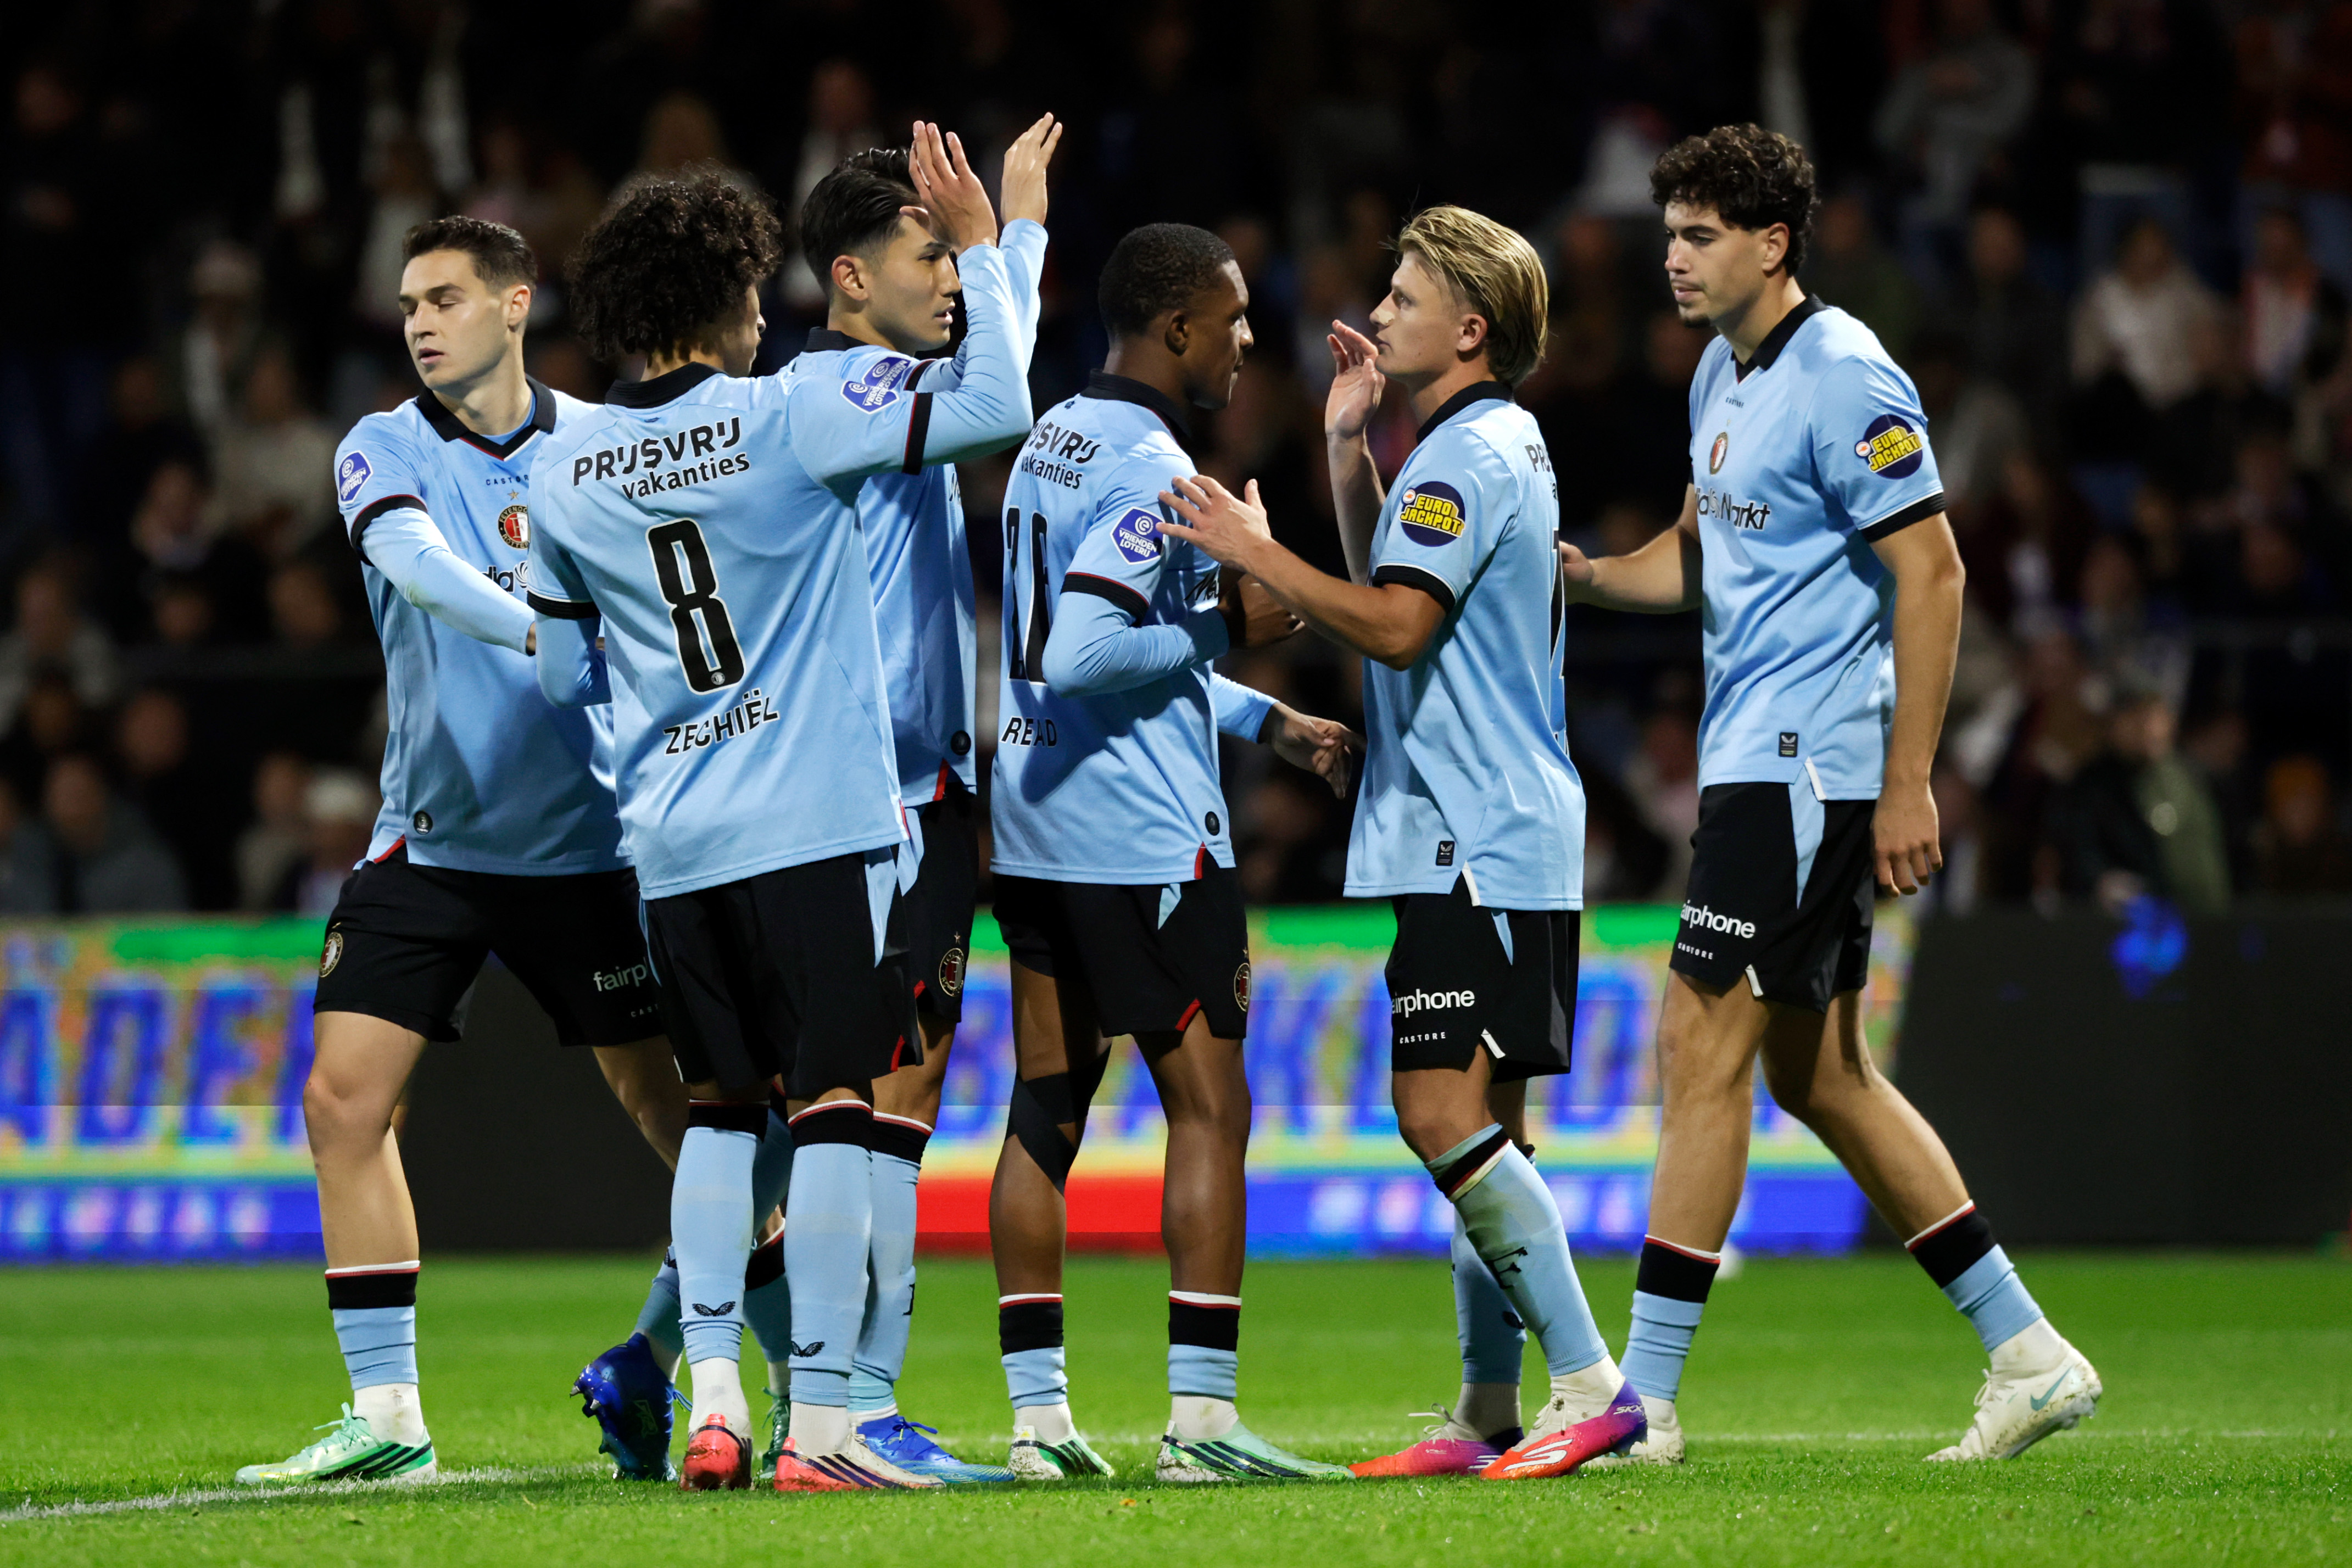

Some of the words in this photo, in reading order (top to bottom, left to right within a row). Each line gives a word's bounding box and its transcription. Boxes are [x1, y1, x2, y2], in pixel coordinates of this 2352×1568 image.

[1870, 435, 1919, 471] JACKPOT
[1872, 428, 1904, 453] EURO
[486, 474, 529, 486] CASTOR
[621, 453, 750, 500] vakanties
[1415, 495, 1453, 516] EURO
[1400, 506, 1461, 533] JACKPOT
[1119, 529, 1157, 553] VRIENDEN
[1119, 538, 1151, 558] LOTERIJ
[645, 517, 747, 696] 8
[663, 687, 780, 756] ZECHIËL
[999, 716, 1058, 747] READ
[1680, 899, 1756, 939] airphone
[1677, 942, 1714, 960] CASTORE
[593, 957, 648, 992] fairp
[1400, 1031, 1446, 1044] CASTORE
